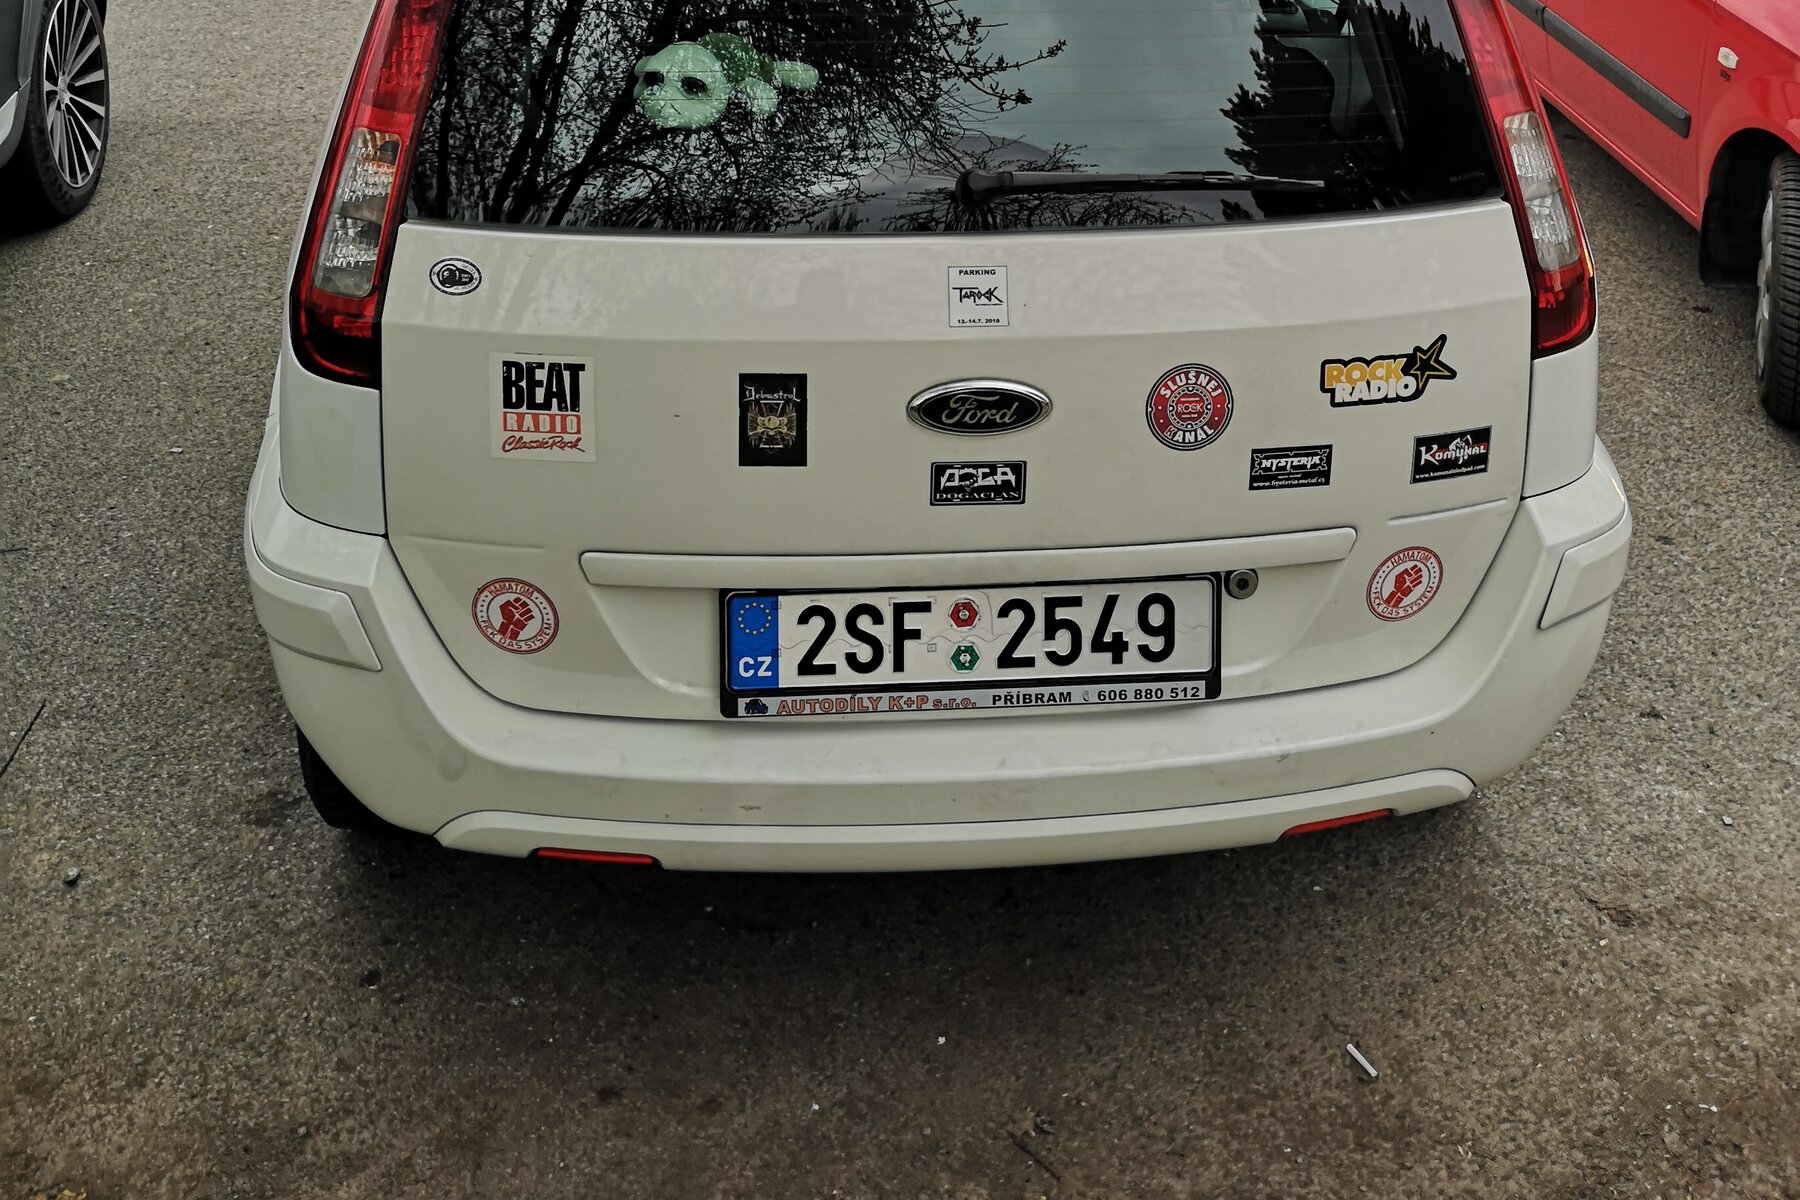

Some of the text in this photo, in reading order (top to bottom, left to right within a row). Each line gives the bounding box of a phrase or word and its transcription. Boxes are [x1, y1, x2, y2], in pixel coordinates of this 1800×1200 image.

[502, 360, 586, 413] BEAT
[1160, 370, 1222, 398] SLUŠNEJ
[1325, 358, 1407, 388] ROCK
[1335, 375, 1417, 403] RADIO
[506, 413, 578, 433] RADIO
[941, 394, 1019, 424] Ford
[1380, 606, 1400, 617] DAS
[1402, 585, 1435, 615] SYSTEM
[498, 638, 523, 650] DAS
[524, 621, 553, 649] SYSTEM
[797, 593, 1176, 676] 2SF 2549
[738, 656, 773, 678] CZ
[776, 686, 1200, 715] AUTODÍLY K+P s.r.o. PŘÍBRAM 606 880 512
